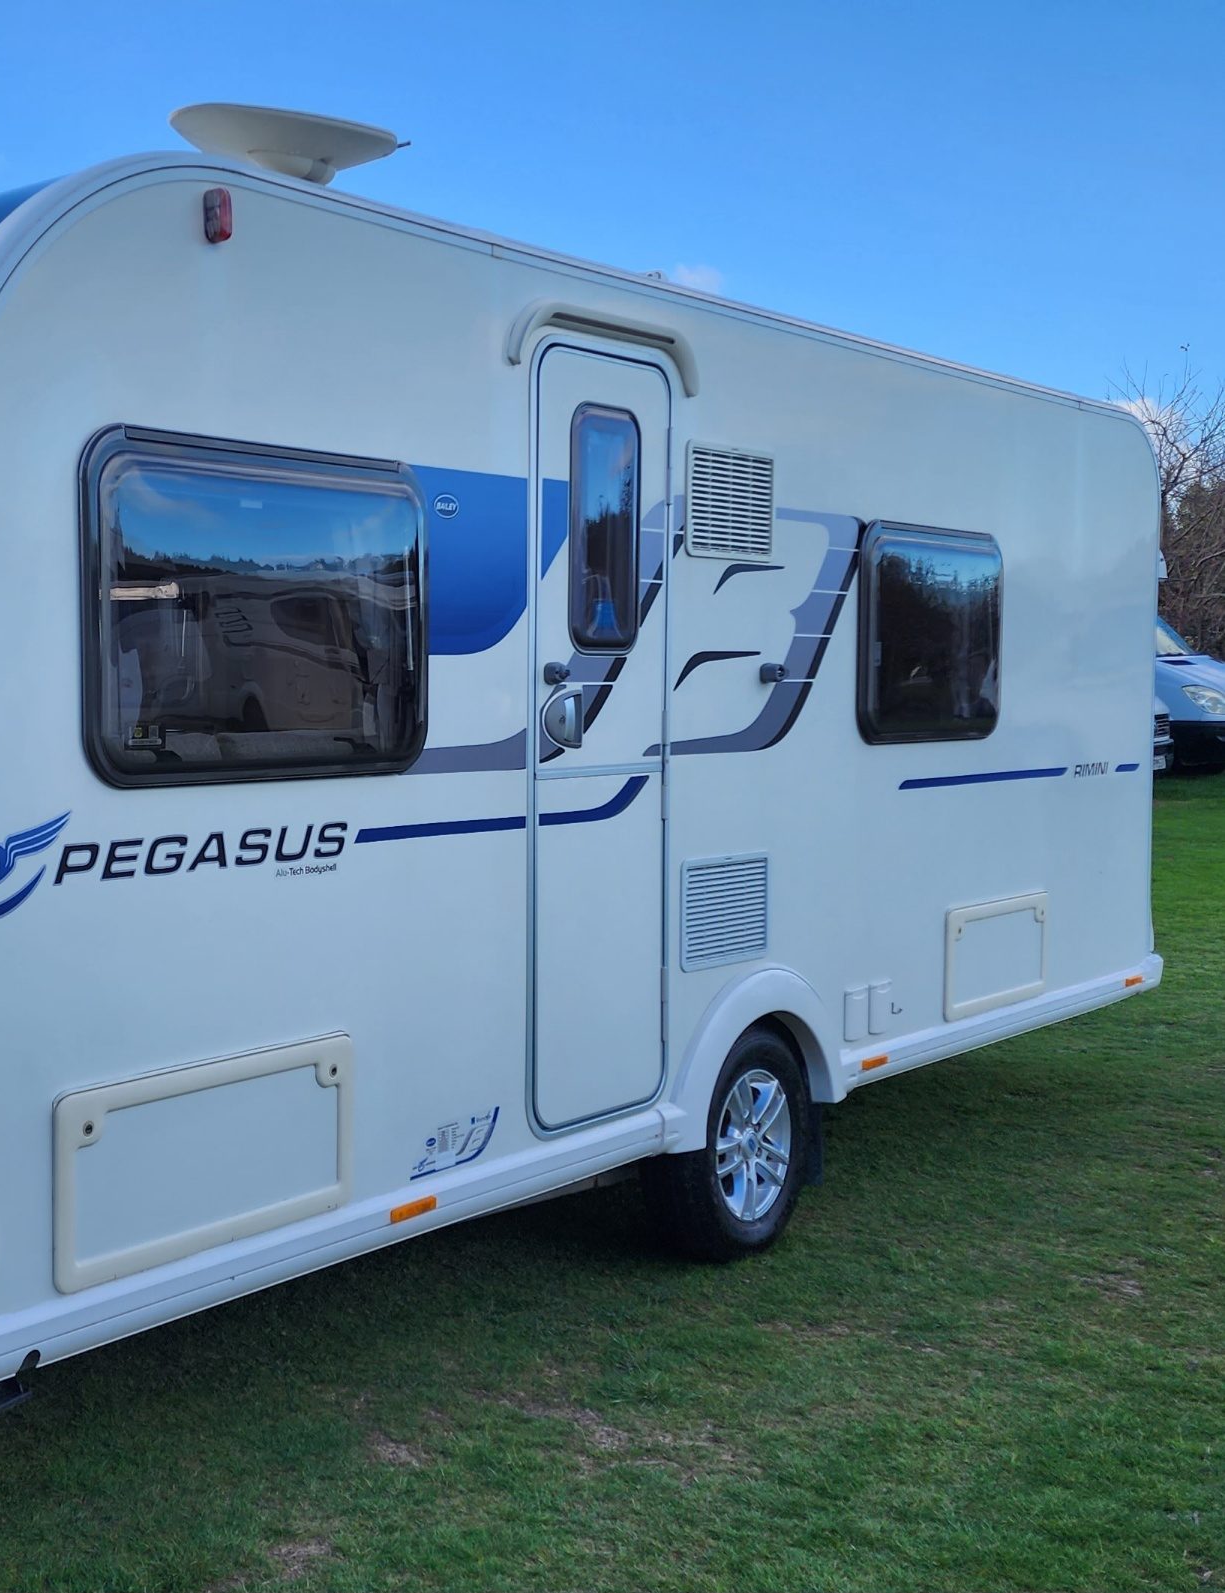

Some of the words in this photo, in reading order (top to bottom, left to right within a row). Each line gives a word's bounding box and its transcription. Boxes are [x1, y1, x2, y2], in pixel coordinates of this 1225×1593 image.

[436, 502, 457, 511] BAILEY
[1074, 761, 1109, 778] RIMINI
[53, 821, 349, 886] PEGASUS
[305, 863, 337, 875] Bodyshell
